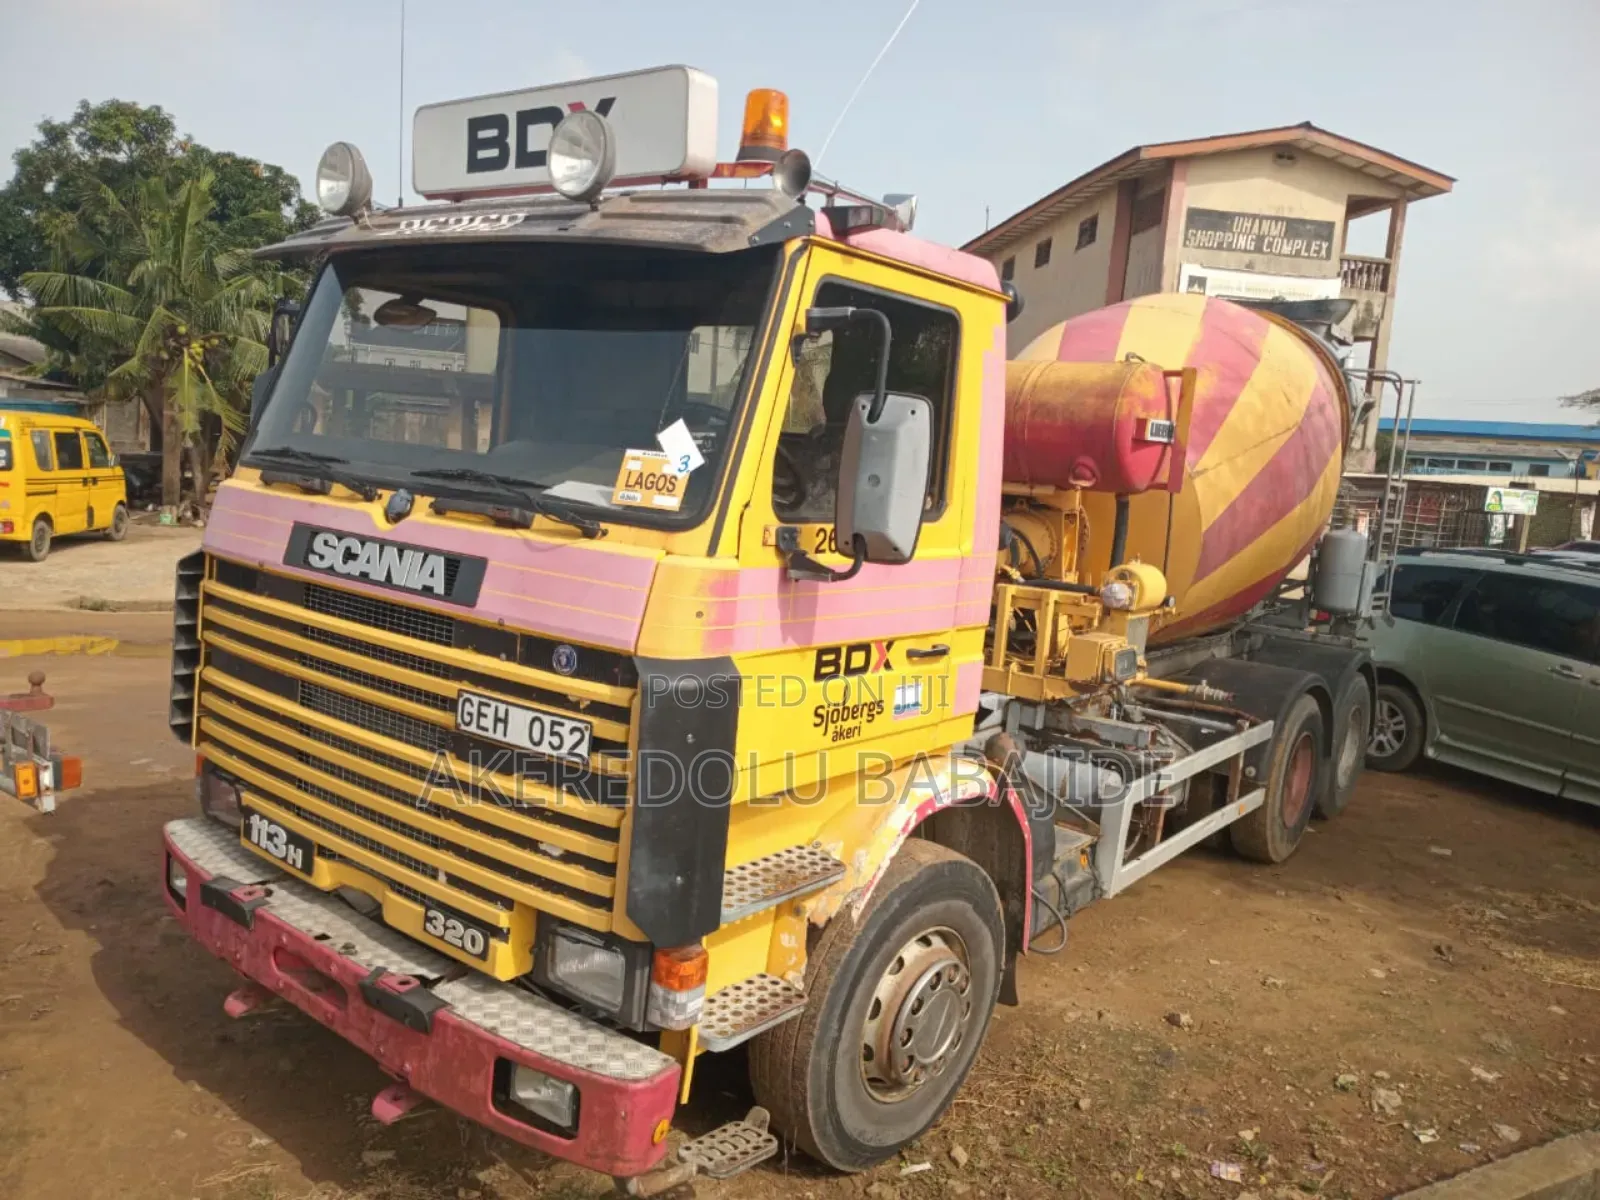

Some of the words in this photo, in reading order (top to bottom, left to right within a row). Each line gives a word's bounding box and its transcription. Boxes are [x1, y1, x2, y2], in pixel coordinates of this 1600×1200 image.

[467, 97, 616, 174] BD
[1185, 229, 1257, 251] SHOPPING
[1263, 236, 1330, 259] COMPLEX
[624, 471, 679, 493] LAGOS
[308, 532, 445, 595] SCANIA
[814, 640, 895, 682] BDX
[460, 697, 510, 738] GEH
[528, 716, 588, 764] 052
[813, 684, 885, 736] Sjöbergs
[832, 722, 862, 742] åkeri
[425, 909, 485, 955] 320
